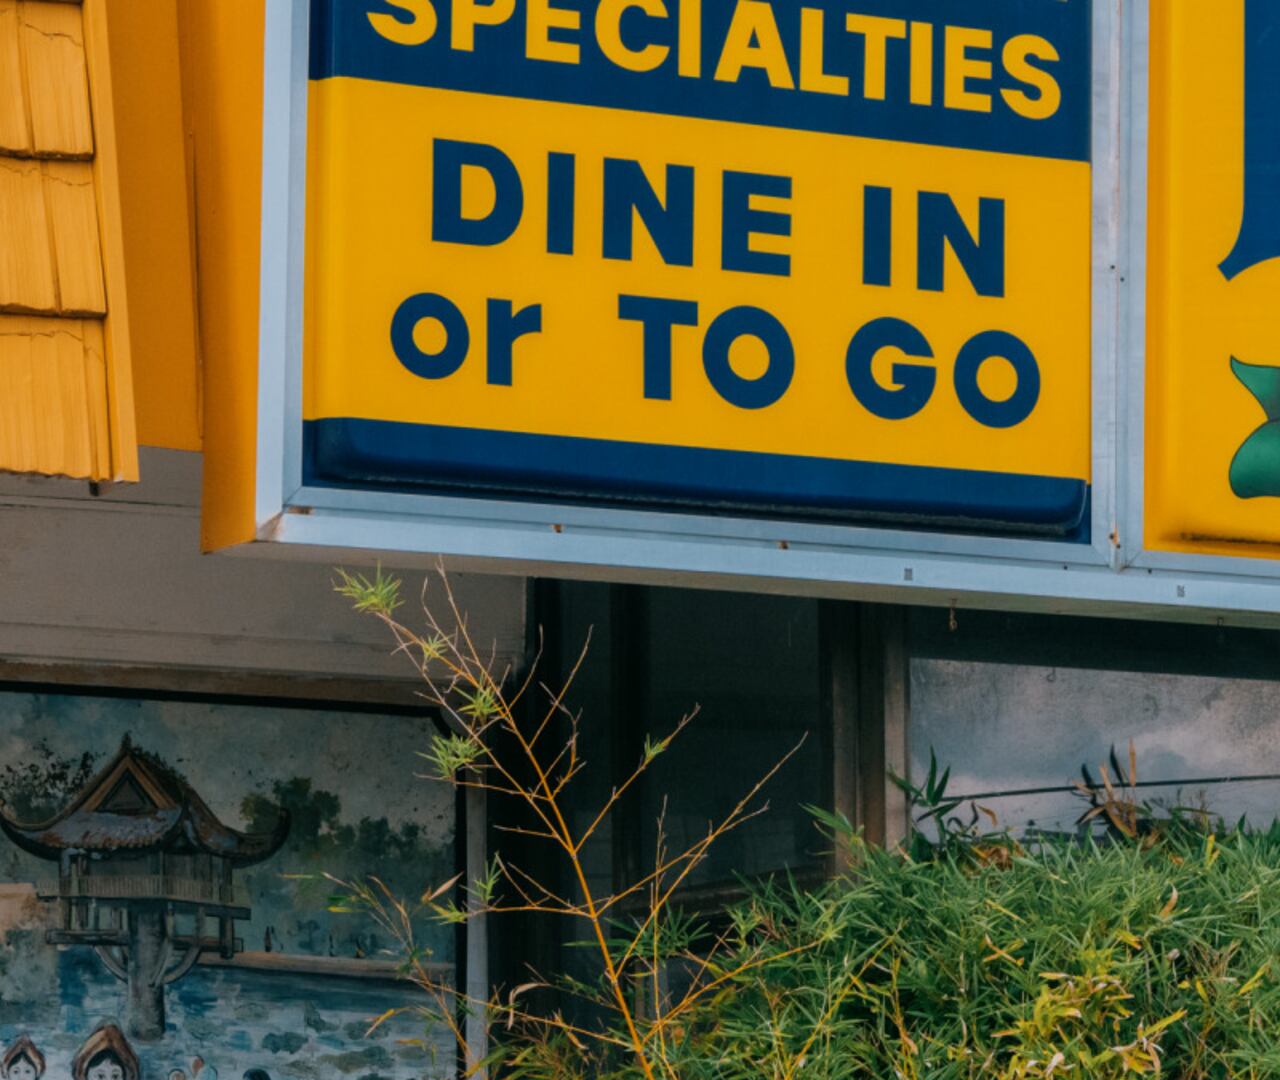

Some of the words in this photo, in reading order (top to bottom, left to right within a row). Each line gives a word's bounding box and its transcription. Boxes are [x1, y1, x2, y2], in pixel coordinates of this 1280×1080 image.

[367, 0, 1061, 120] SPECIALTIES
[431, 138, 793, 277] DINE
[862, 185, 1005, 298] IN
[390, 292, 542, 386] or
[617, 294, 795, 410] TO
[845, 316, 1041, 429] GO
